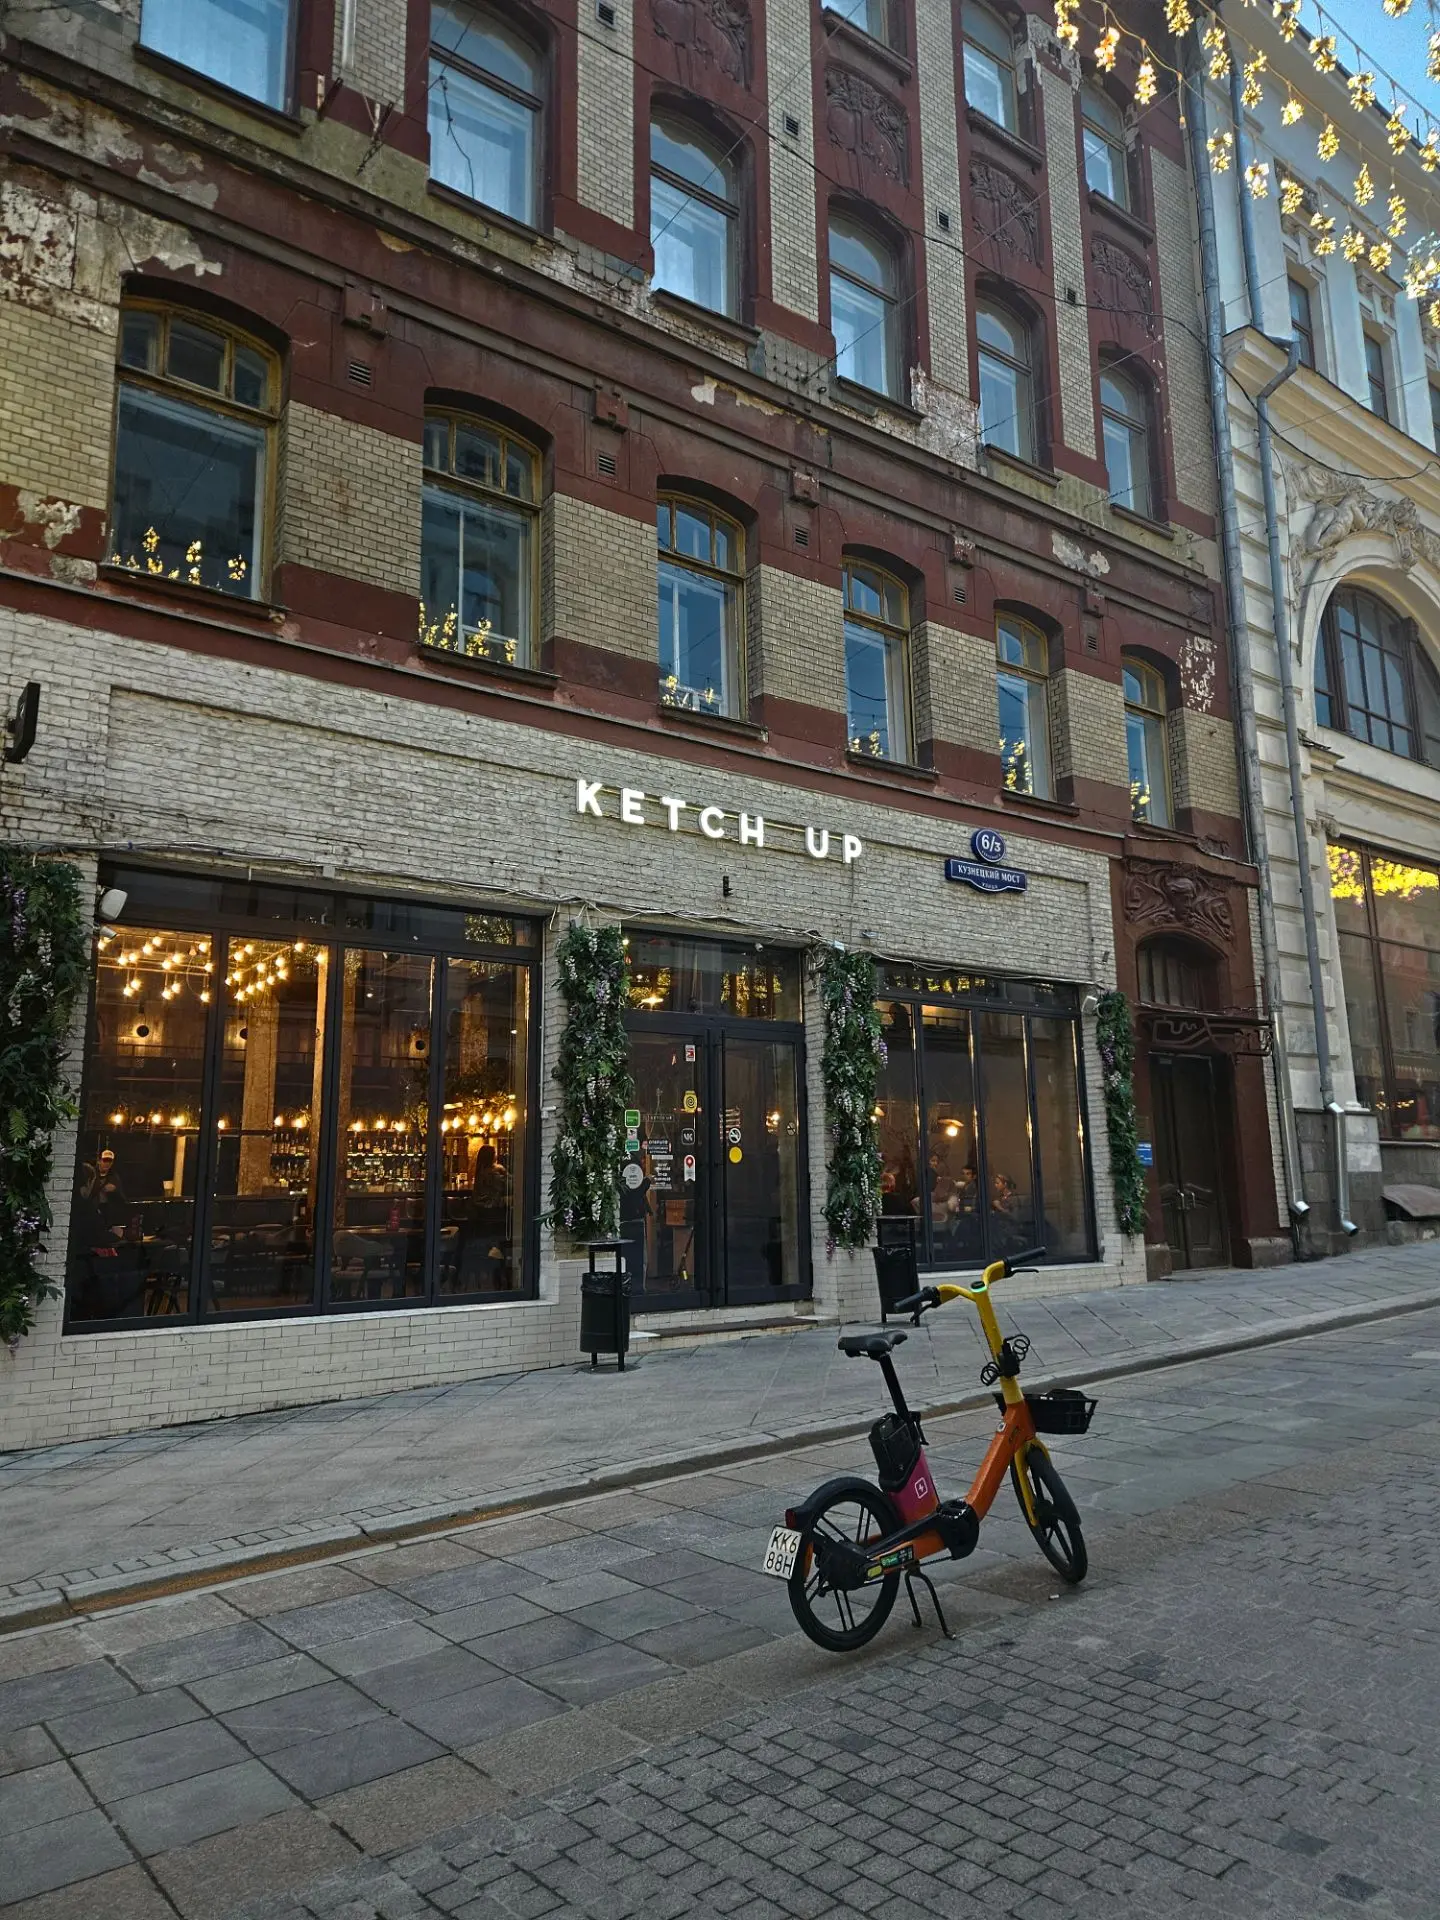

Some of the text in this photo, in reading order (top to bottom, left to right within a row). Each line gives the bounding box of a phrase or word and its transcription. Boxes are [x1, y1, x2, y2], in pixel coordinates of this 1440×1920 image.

[576, 779, 863, 864] KETCH UP
[981, 834, 1001, 852] 6/3
[957, 864, 1020, 884] КУЗНЕЦКИЙ МОСТ
